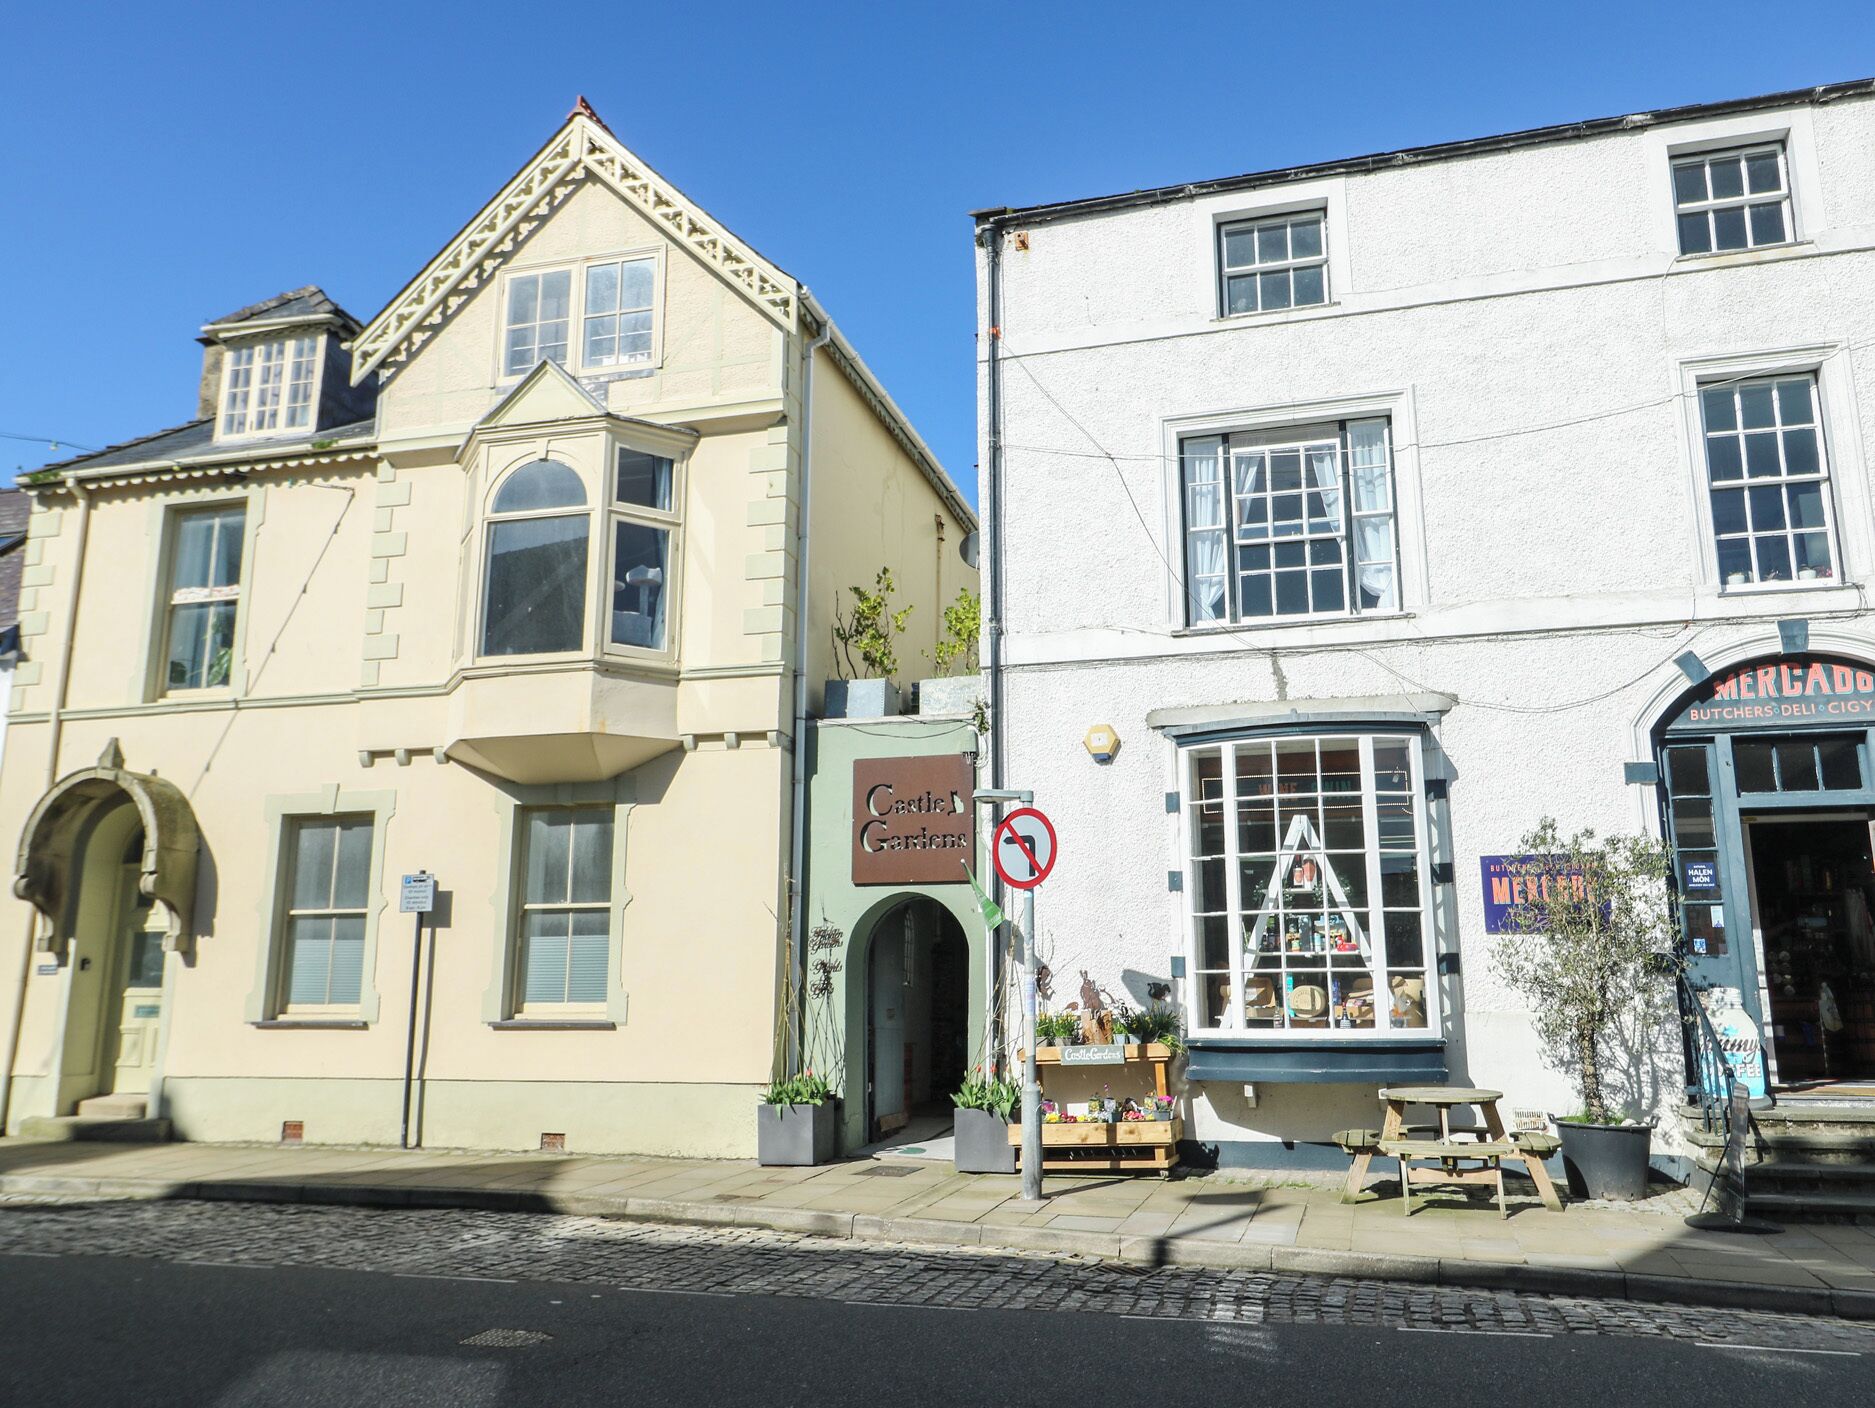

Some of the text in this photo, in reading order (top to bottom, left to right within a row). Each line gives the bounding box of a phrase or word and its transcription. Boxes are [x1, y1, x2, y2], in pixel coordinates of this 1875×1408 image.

[1714, 661, 1873, 700] MERCADO
[1690, 700, 1873, 721] BUTCHERS DELI CIGY
[866, 783, 945, 817] Castle
[860, 819, 967, 853] Gardens
